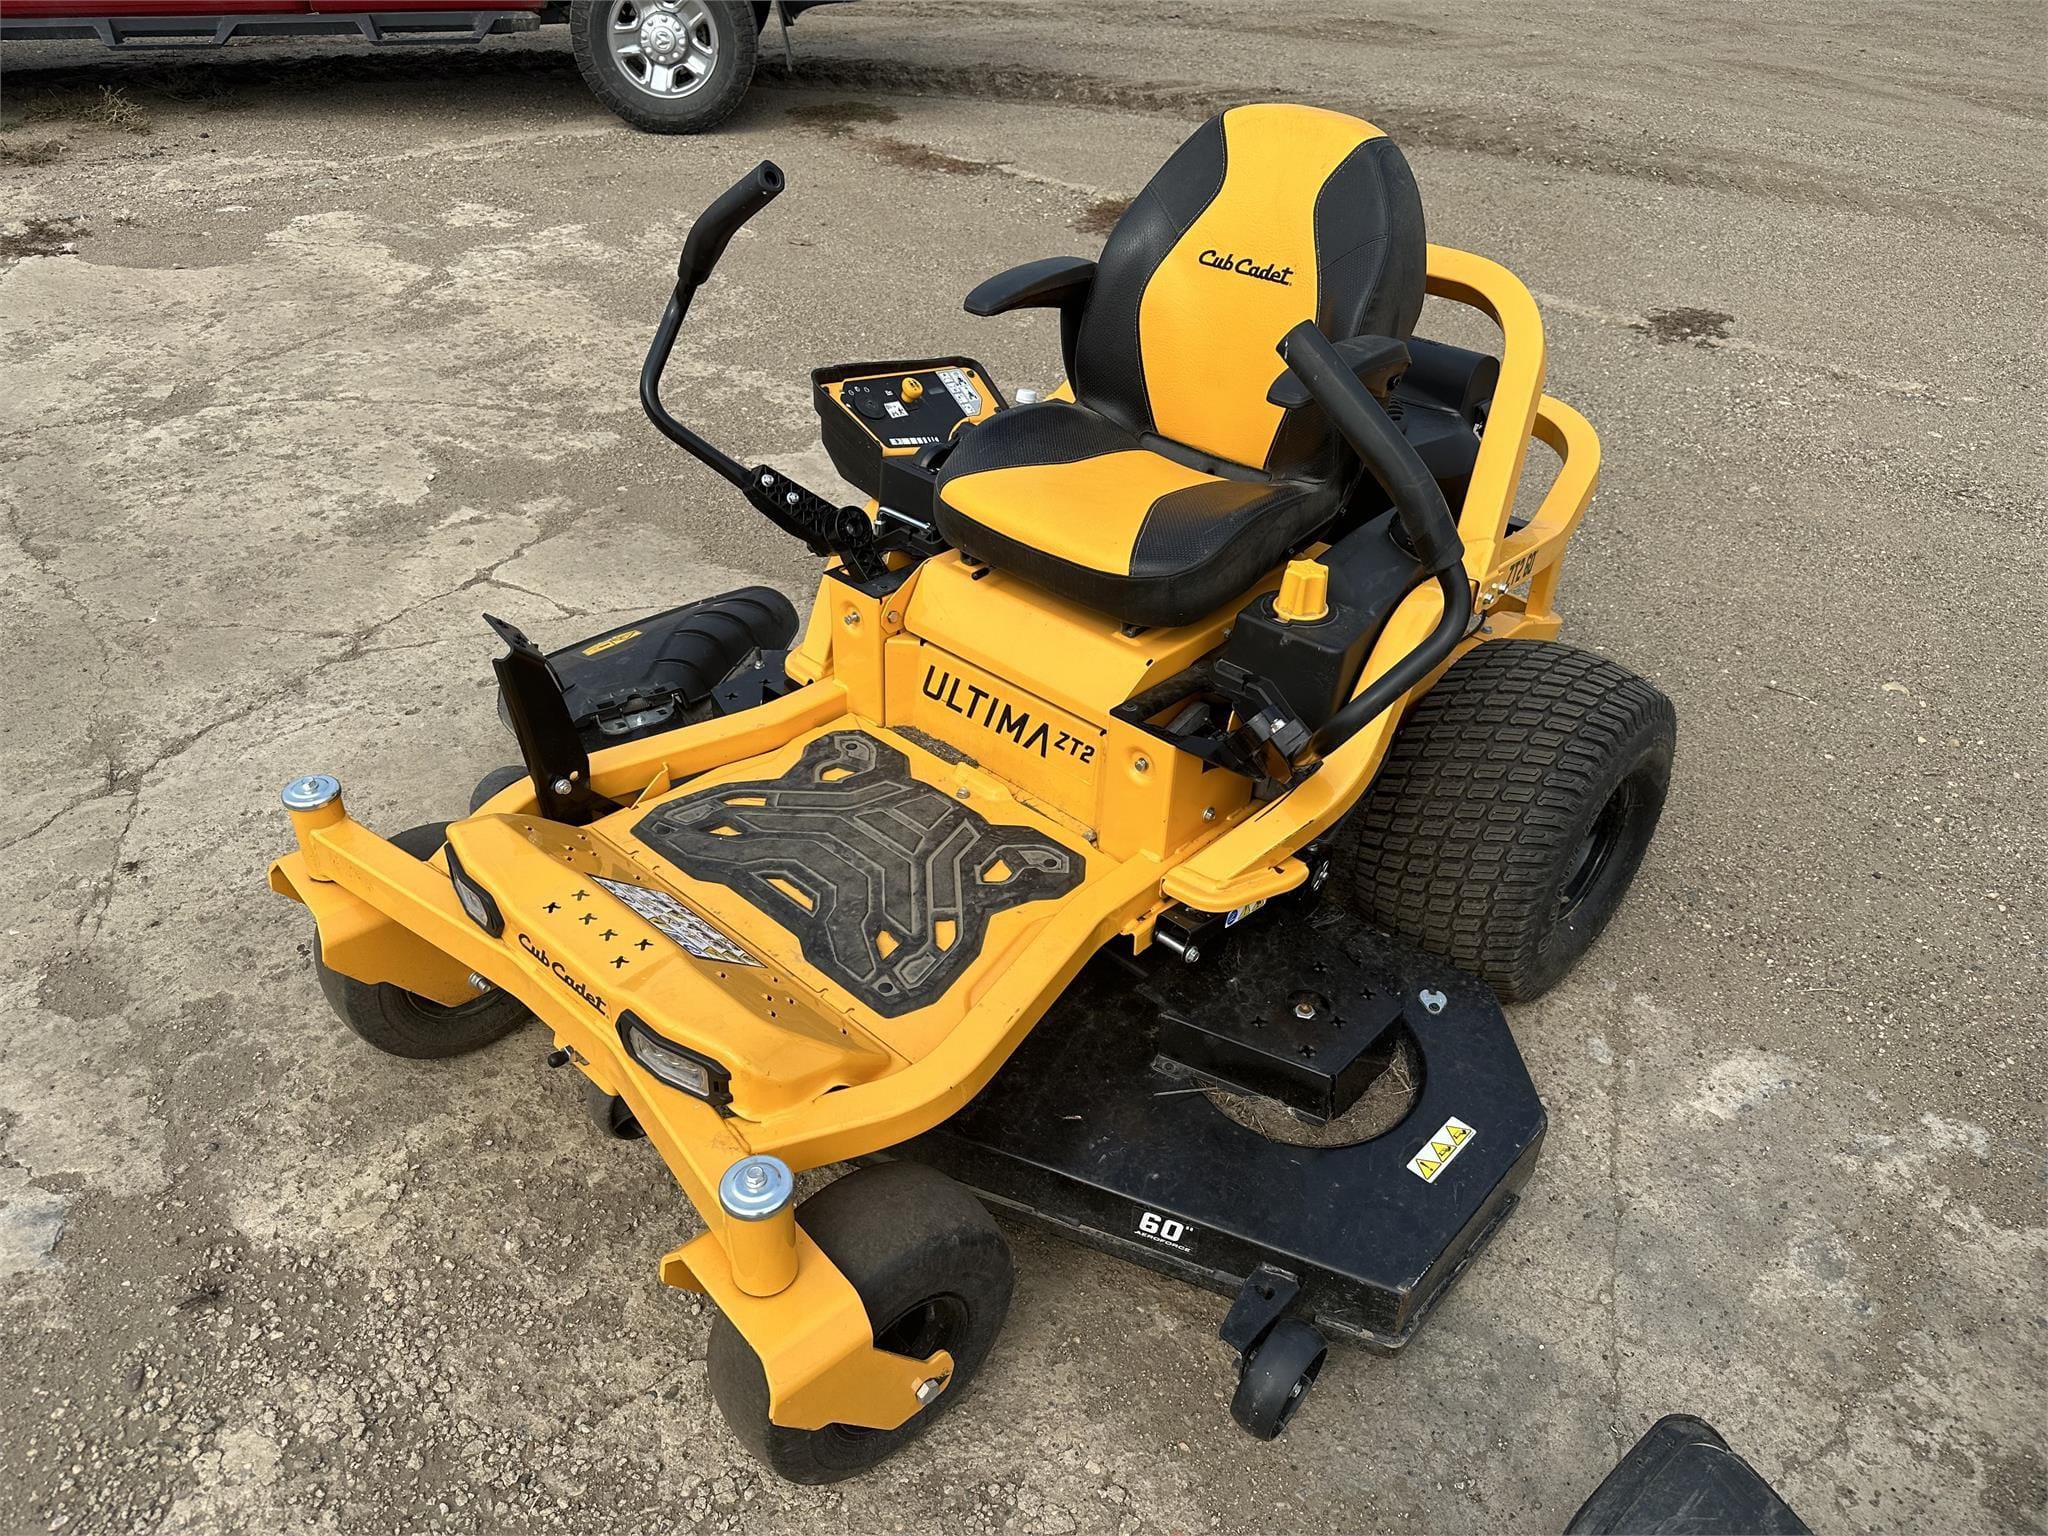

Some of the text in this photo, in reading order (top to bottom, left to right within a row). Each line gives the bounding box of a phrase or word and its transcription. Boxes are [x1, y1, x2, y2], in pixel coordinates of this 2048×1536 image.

[1198, 249, 1294, 286] Cub Cadet
[922, 664, 1096, 765] ULTIMA ZT2
[518, 933, 607, 1016] Cub Cadet
[1133, 1230, 1192, 1253] AEROFORCE
[1138, 1211, 1194, 1242] 60"
